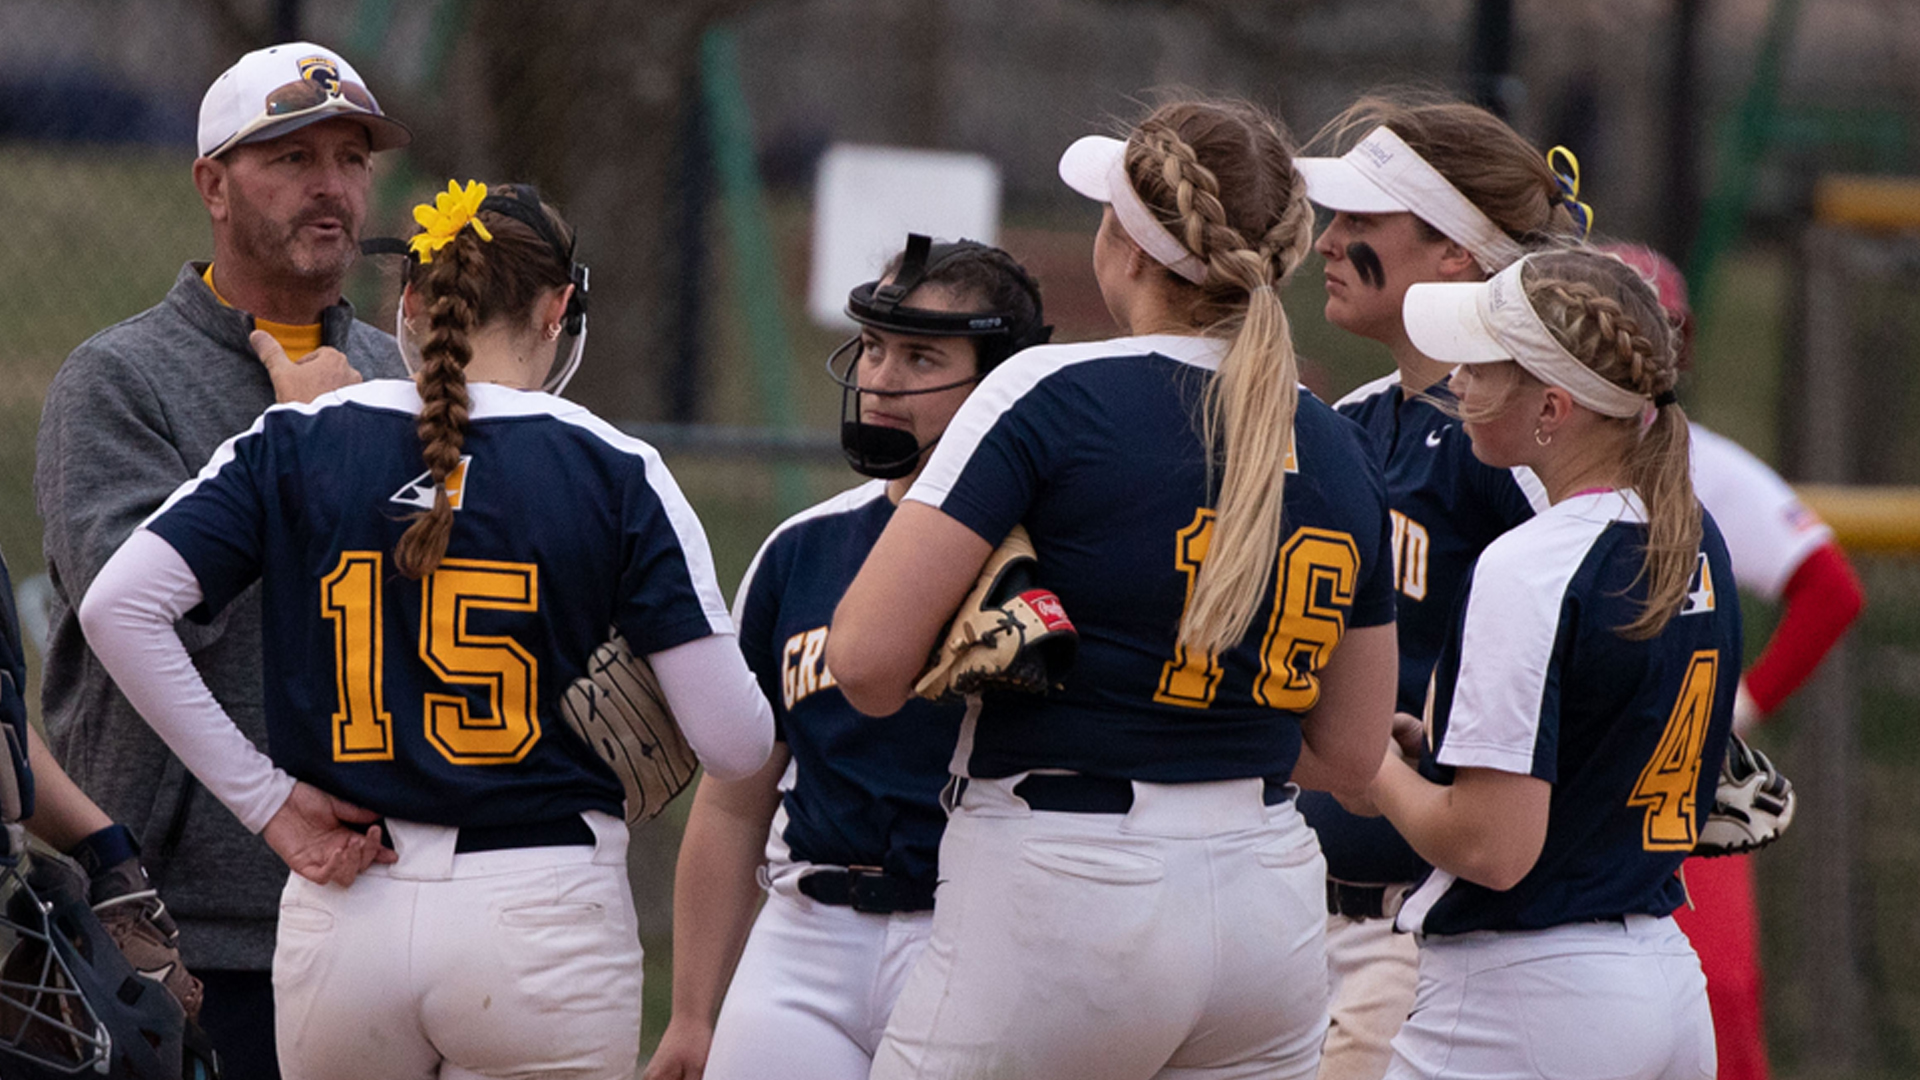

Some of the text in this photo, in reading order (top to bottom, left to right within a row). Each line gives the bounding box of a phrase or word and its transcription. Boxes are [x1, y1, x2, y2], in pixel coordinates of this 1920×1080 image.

[320, 551, 542, 765] 15
[1152, 507, 1361, 713] 16
[1627, 649, 1719, 852] 4
